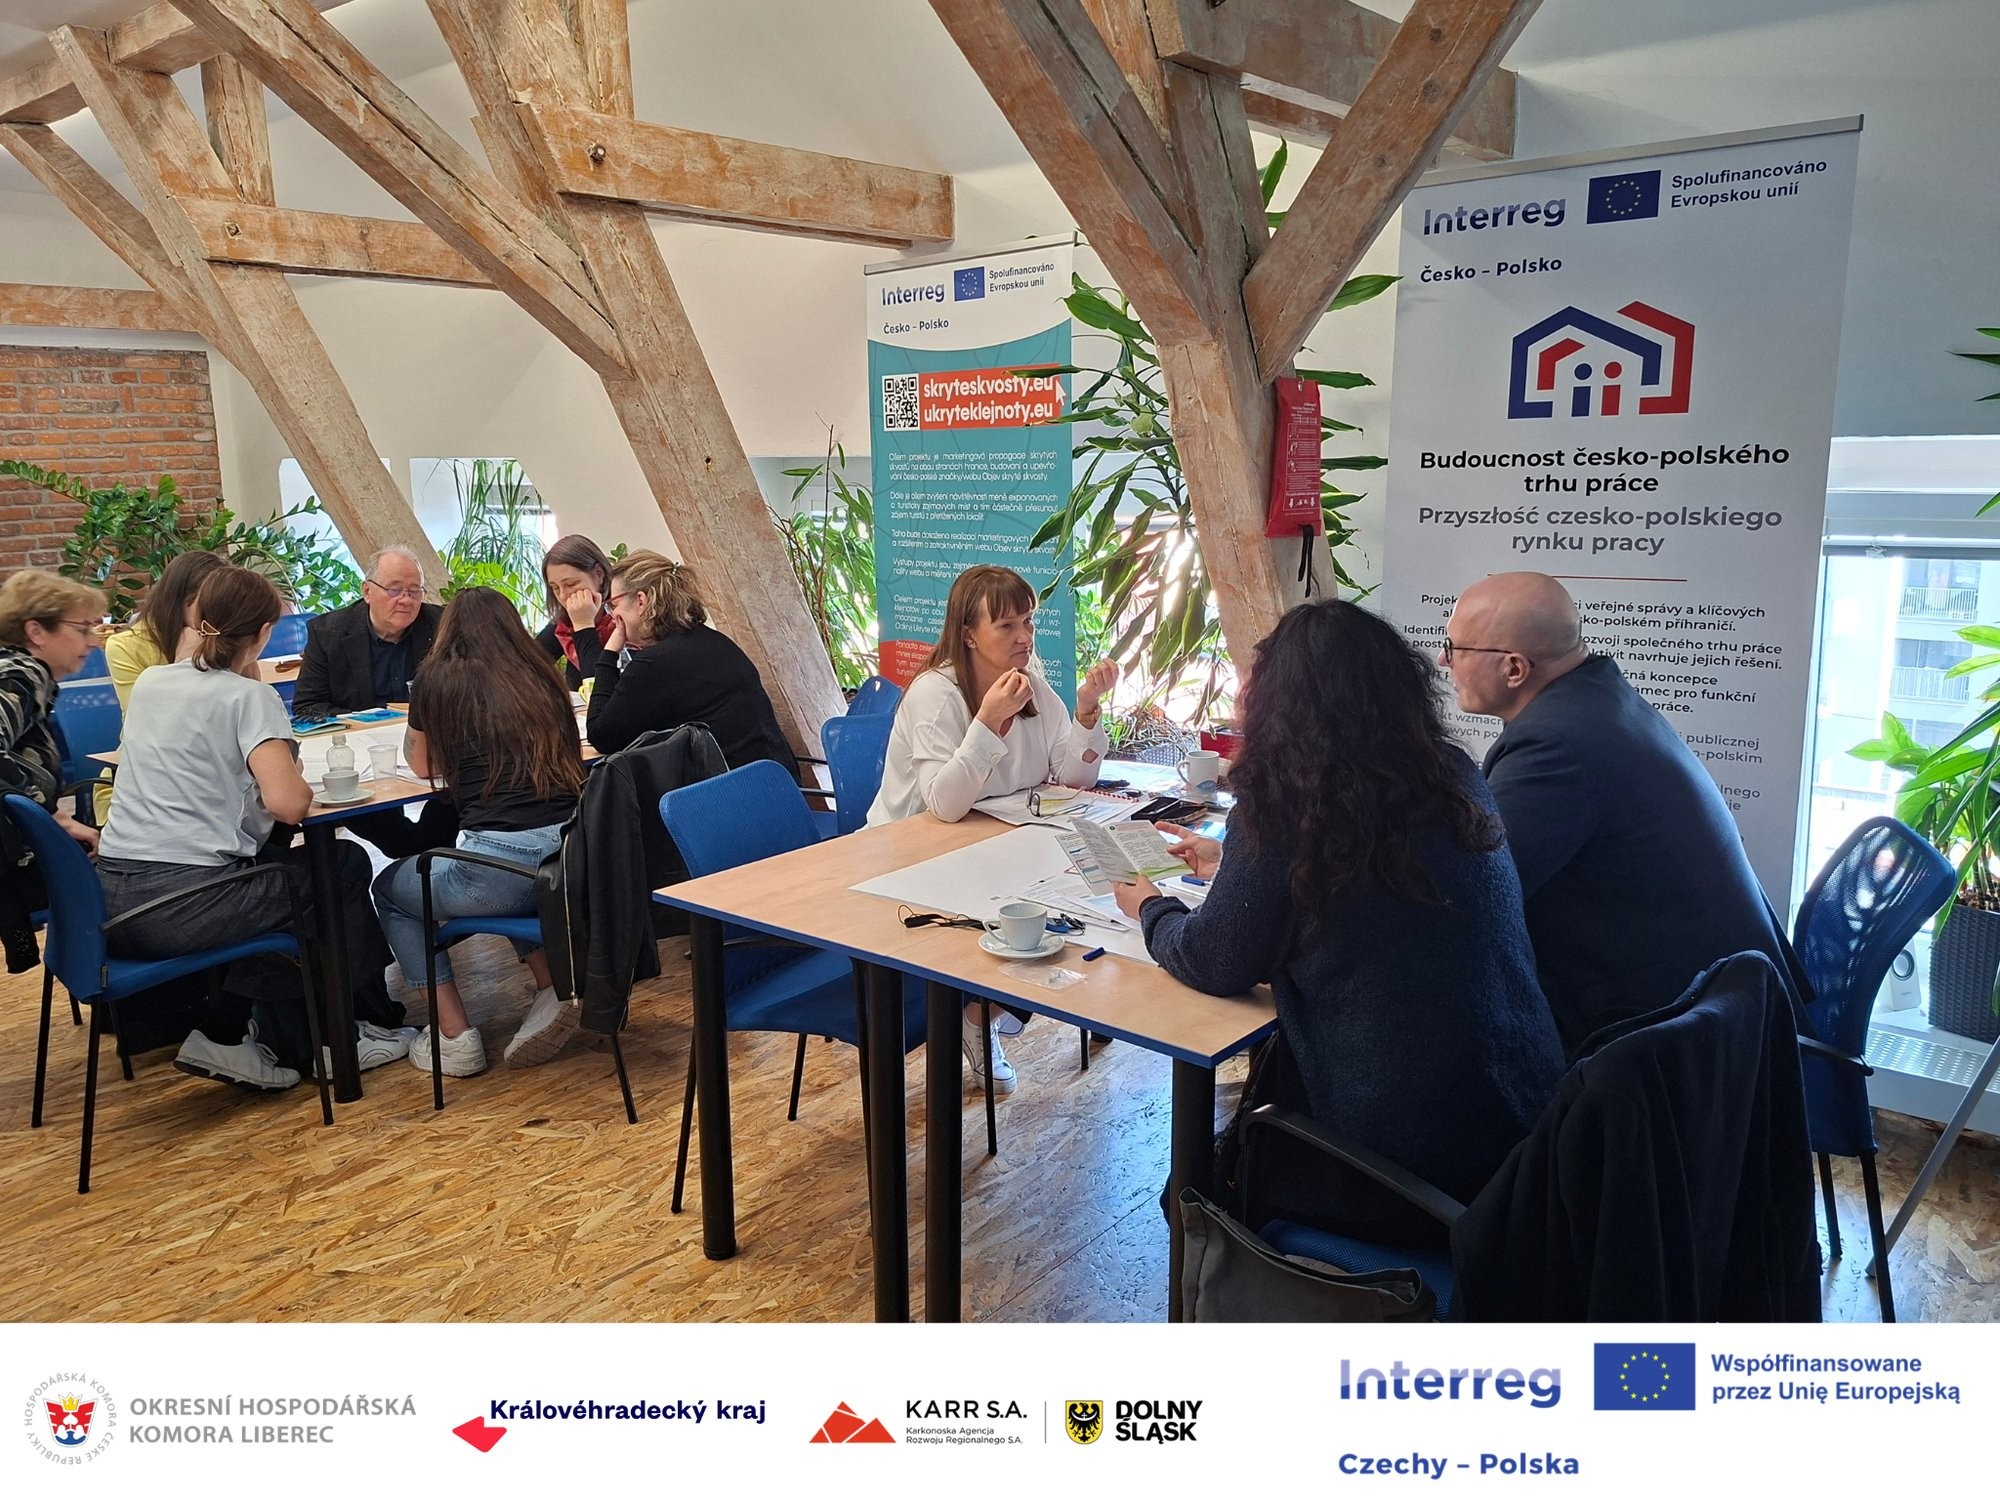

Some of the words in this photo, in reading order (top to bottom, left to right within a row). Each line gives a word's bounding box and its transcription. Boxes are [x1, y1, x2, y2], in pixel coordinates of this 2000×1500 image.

[1671, 161, 1827, 190] Spolufinancováno
[1671, 189, 1761, 208] Evropskou
[1766, 181, 1800, 198] unií
[1423, 198, 1567, 236] Interreg
[989, 263, 1055, 280] Spolufinancováno
[1420, 265, 1476, 283] Česko
[1496, 257, 1562, 276] Polsko
[882, 283, 945, 306] Interreg
[989, 279, 1029, 293] Evropskou
[1030, 277, 1045, 287] unií
[883, 322, 911, 335] Česko
[919, 318, 950, 331] Polsko
[924, 374, 1054, 401] skryteskvosty.eu
[924, 400, 1054, 425] ukryteklejnoty.eu
[1420, 450, 1566, 469] Budoucnost
[1573, 444, 1790, 469] česko-polského
[1524, 474, 1577, 492] trhu
[1586, 473, 1659, 496] práce
[1419, 505, 1540, 528] Przyszłość
[1546, 505, 1783, 531] czesko-polskiego
[1512, 532, 1584, 553] rynku
[1592, 536, 1665, 556] pracy
[1585, 601, 1635, 614] veřejné
[1637, 603, 1682, 617] správy
[1686, 606, 1694, 615] a
[1698, 604, 1766, 619] klíčových
[1580, 614, 1661, 629] ko-polském
[1665, 619, 1736, 632] příhraničí.
[1623, 637, 1704, 651] společného
[1707, 640, 1738, 652] trhu
[1742, 642, 1783, 655] práce
[1629, 652, 1689, 665] navrhuje
[1690, 653, 1731, 667] jejich
[1735, 656, 1783, 670] řešení.
[1650, 671, 1718, 686] koncepce
[1634, 685, 1670, 697] ámec
[1674, 688, 1698, 700] pro
[1701, 689, 1757, 703] funkční
[1652, 702, 1694, 713] práce.
[1686, 734, 1760, 751] publicznej
